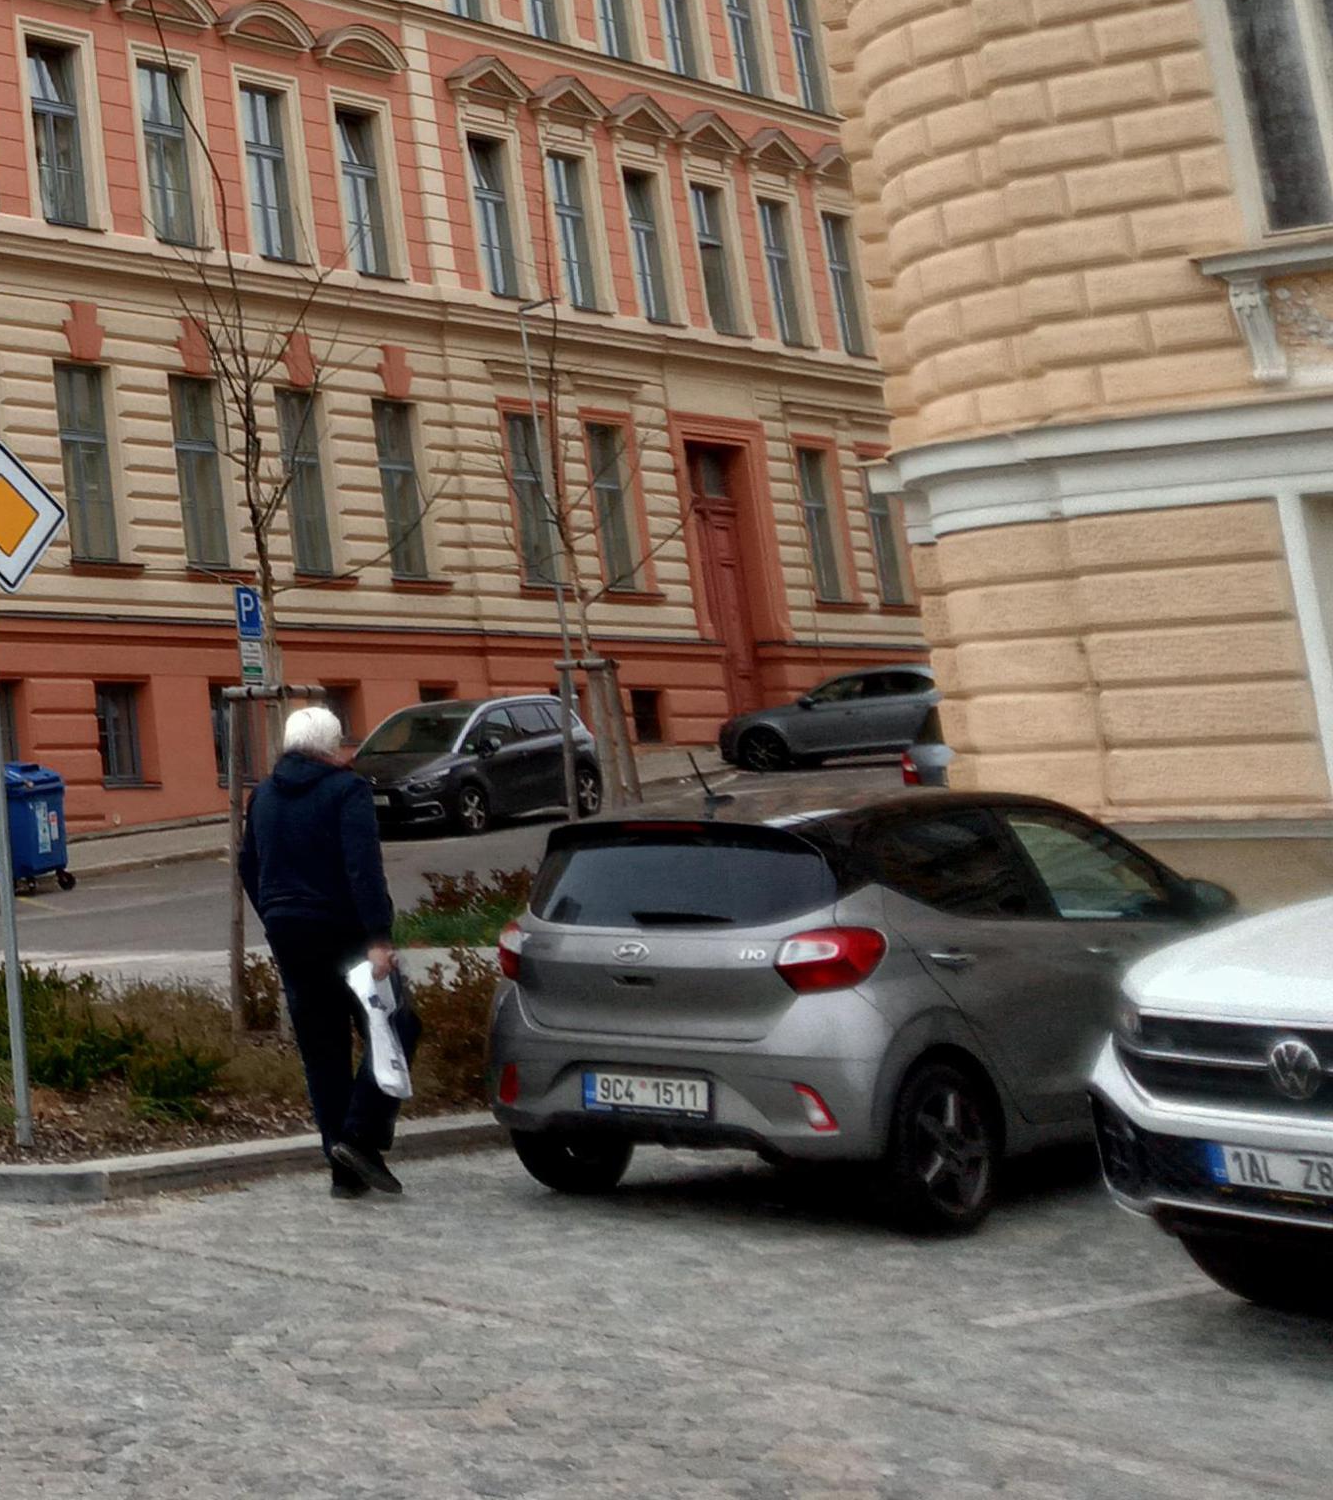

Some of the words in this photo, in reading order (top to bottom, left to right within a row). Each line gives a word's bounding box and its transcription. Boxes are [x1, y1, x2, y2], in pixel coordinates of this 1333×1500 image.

[240, 593, 254, 622] P
[600, 1077, 635, 1103] 9C4
[652, 1081, 698, 1107] 1511
[1232, 1152, 1281, 1186] 1AL
